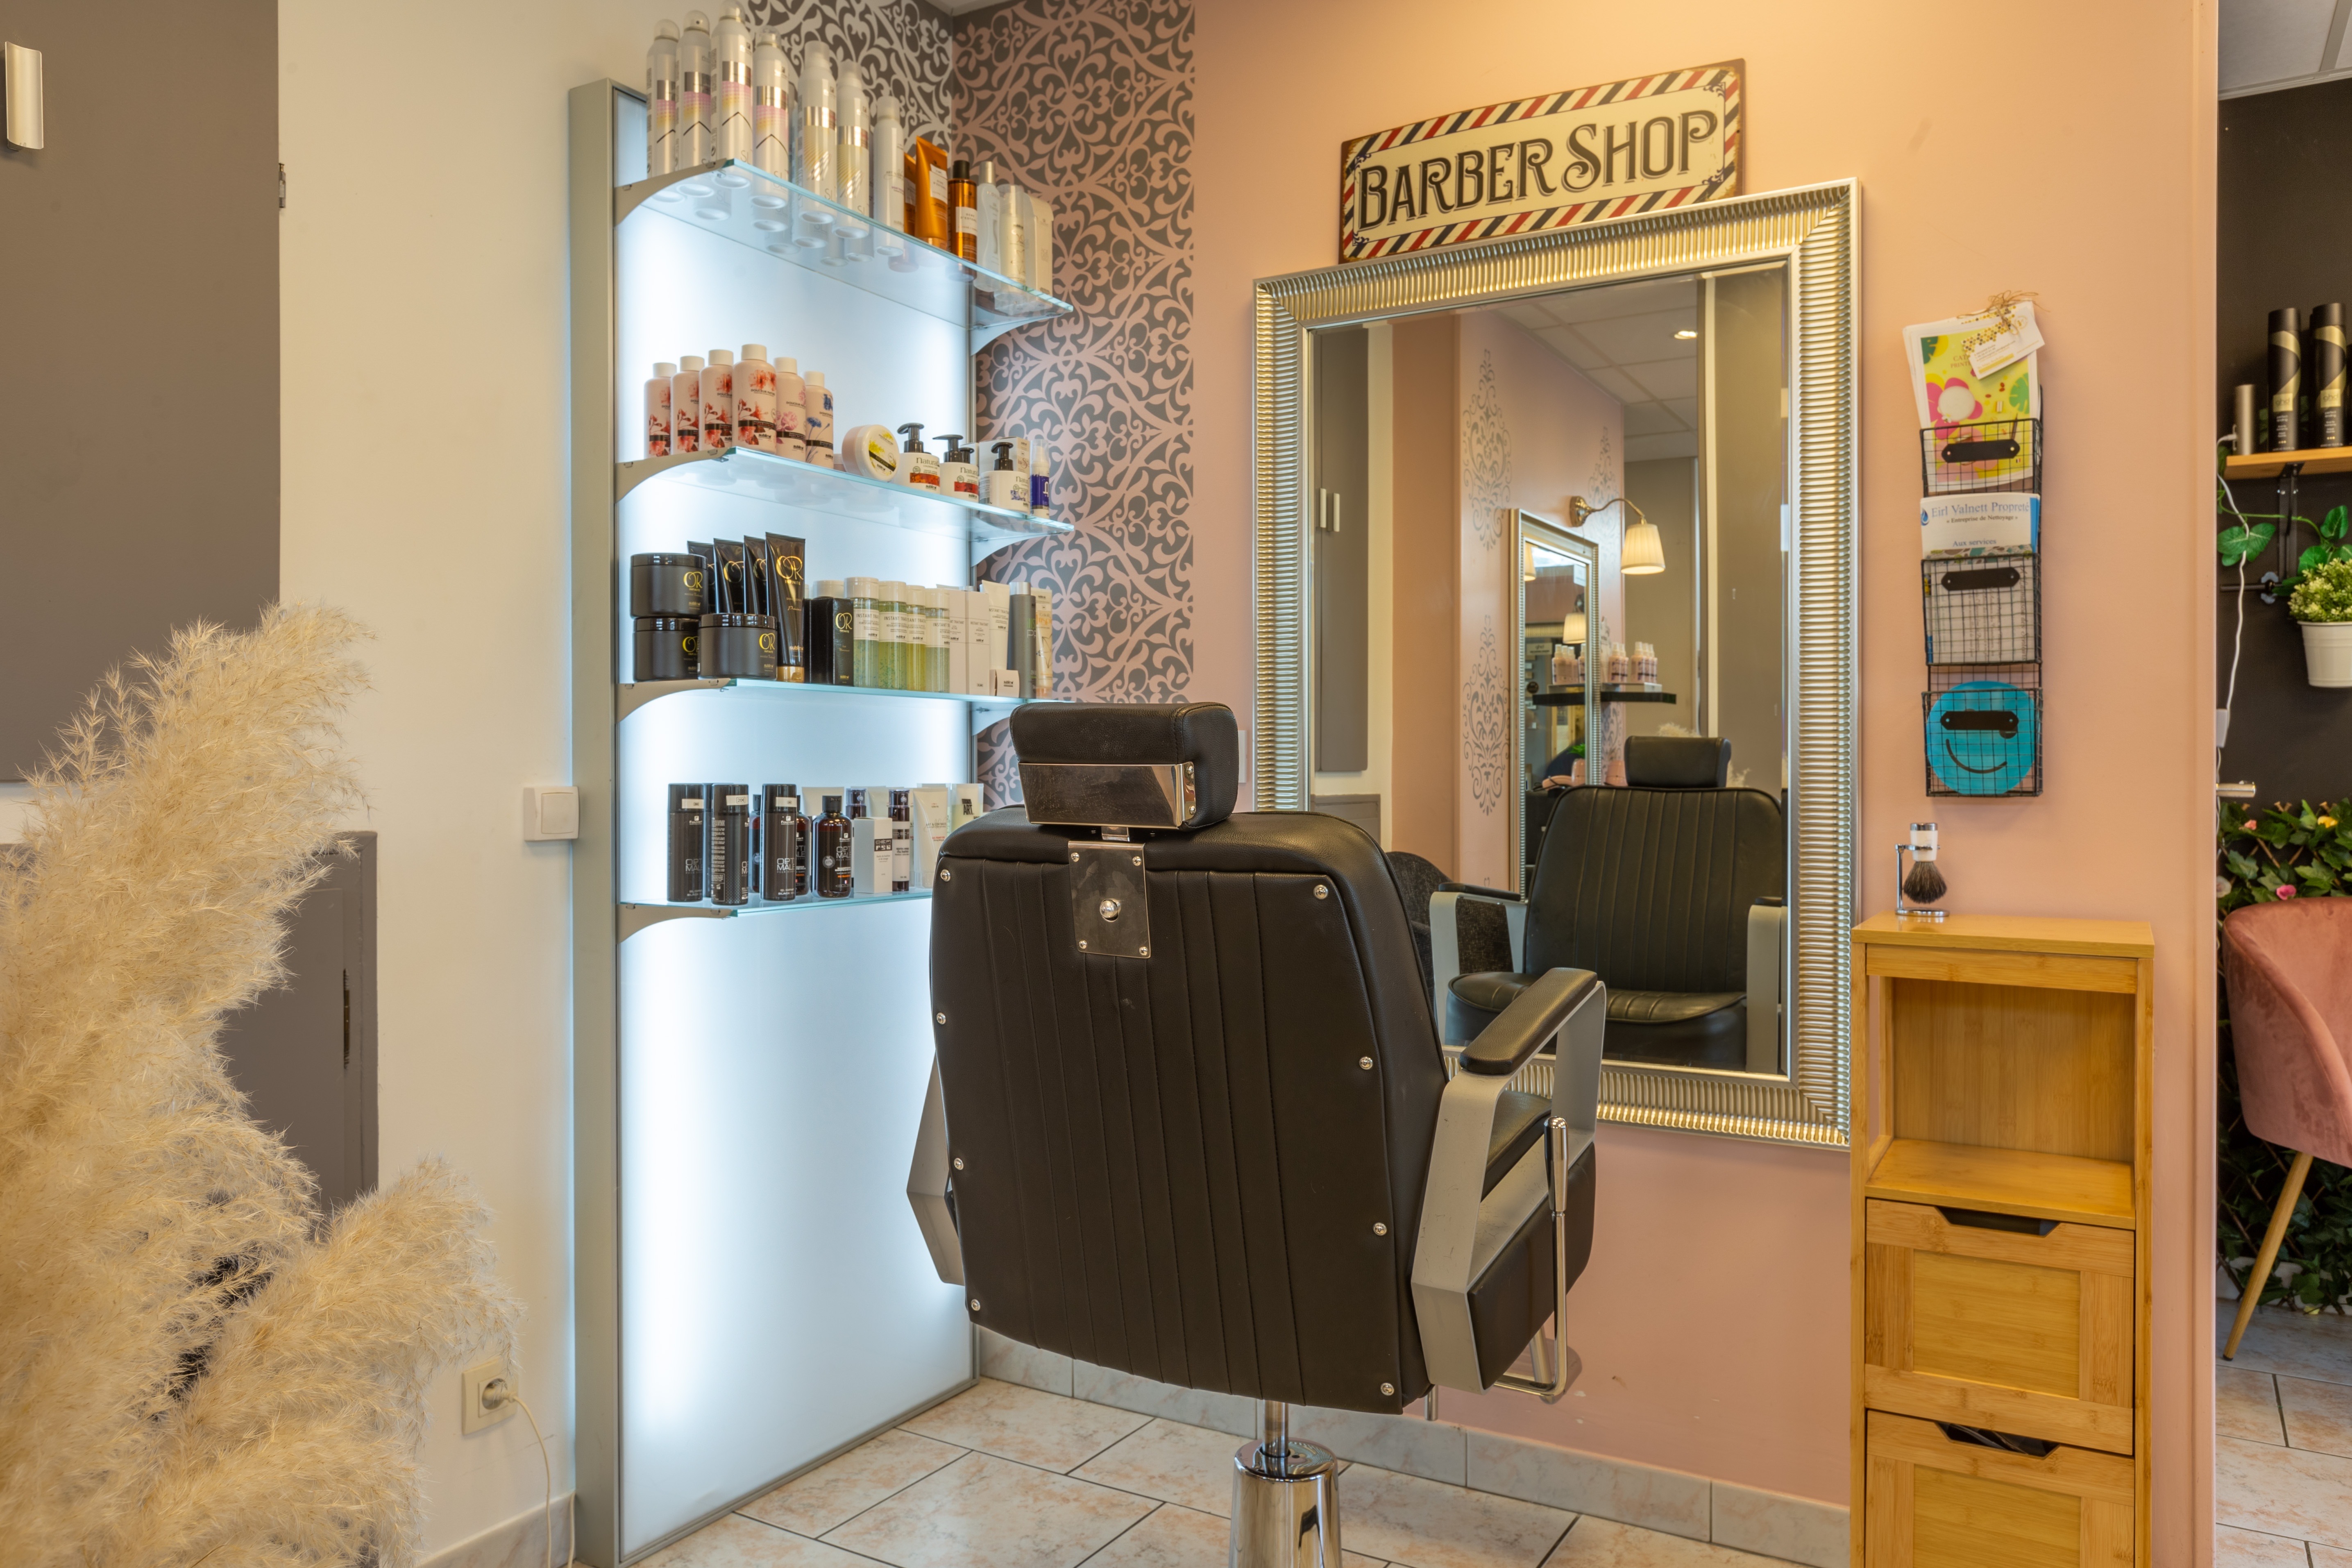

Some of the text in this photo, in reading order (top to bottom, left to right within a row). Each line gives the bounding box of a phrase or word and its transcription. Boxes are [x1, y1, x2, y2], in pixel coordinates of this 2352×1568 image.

[1358, 110, 1718, 231] BARBER SHOP
[1931, 502, 2030, 517] Eirl Valnett Propreté
[963, 804, 973, 815] ART
